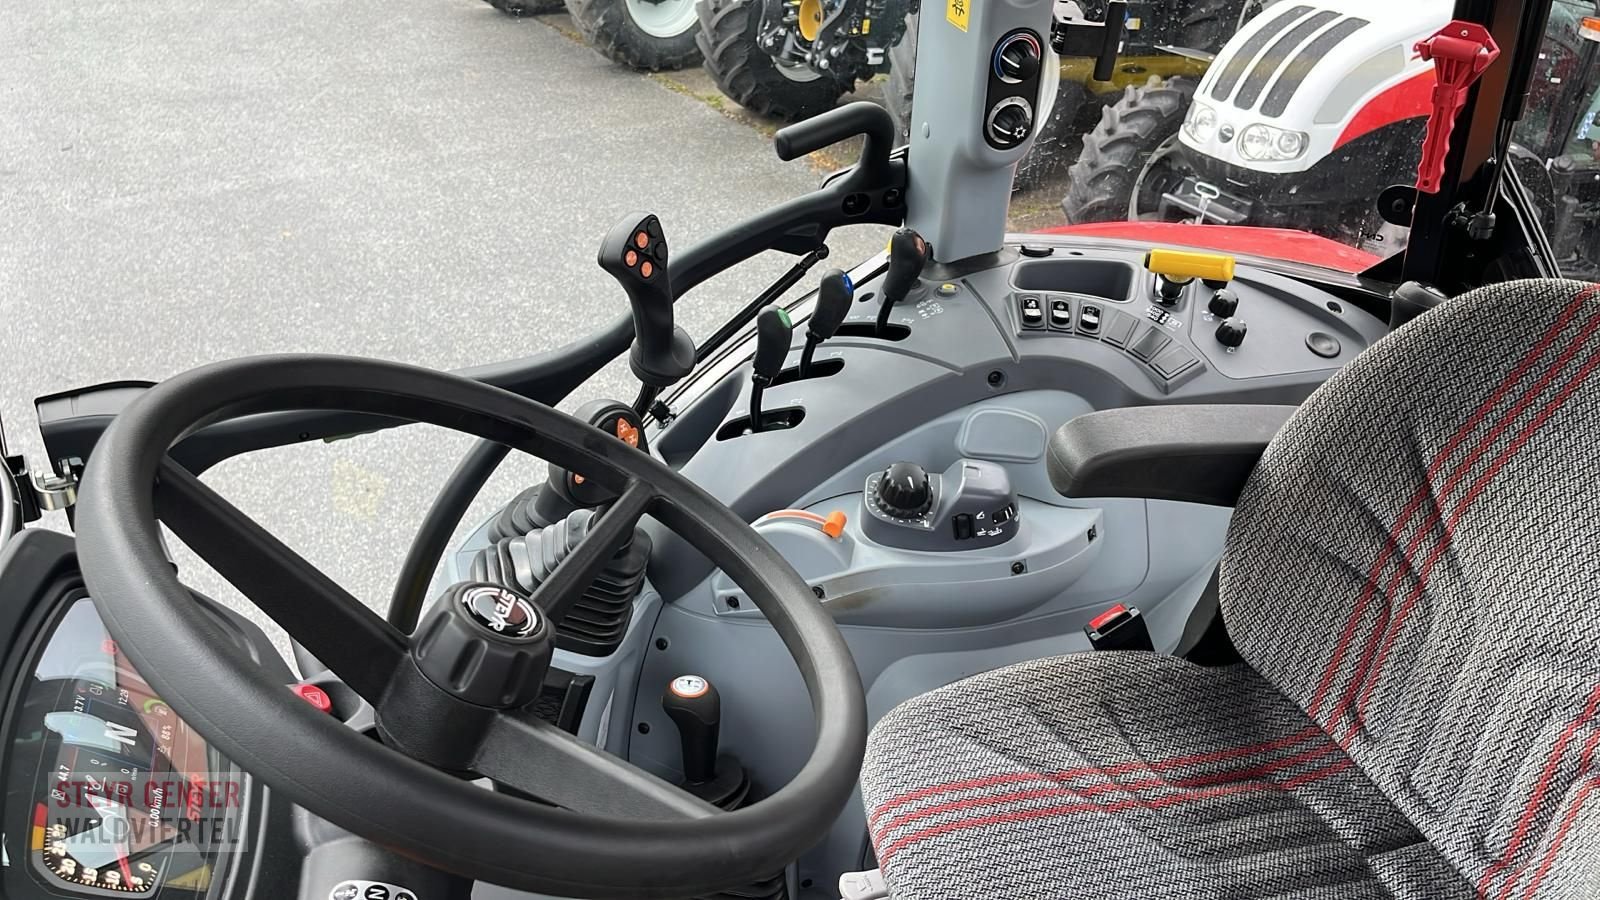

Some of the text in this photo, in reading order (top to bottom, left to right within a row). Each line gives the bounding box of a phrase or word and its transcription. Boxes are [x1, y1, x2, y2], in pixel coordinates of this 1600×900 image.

[487, 589, 517, 632] STEYR
[104, 721, 138, 746] N
[187, 773, 209, 825] STEYR
[60, 858, 76, 876] 20
[81, 867, 98, 882] 15
[138, 862, 152, 872] 0
[104, 870, 121, 886] 10
[130, 876, 144, 886] 5
